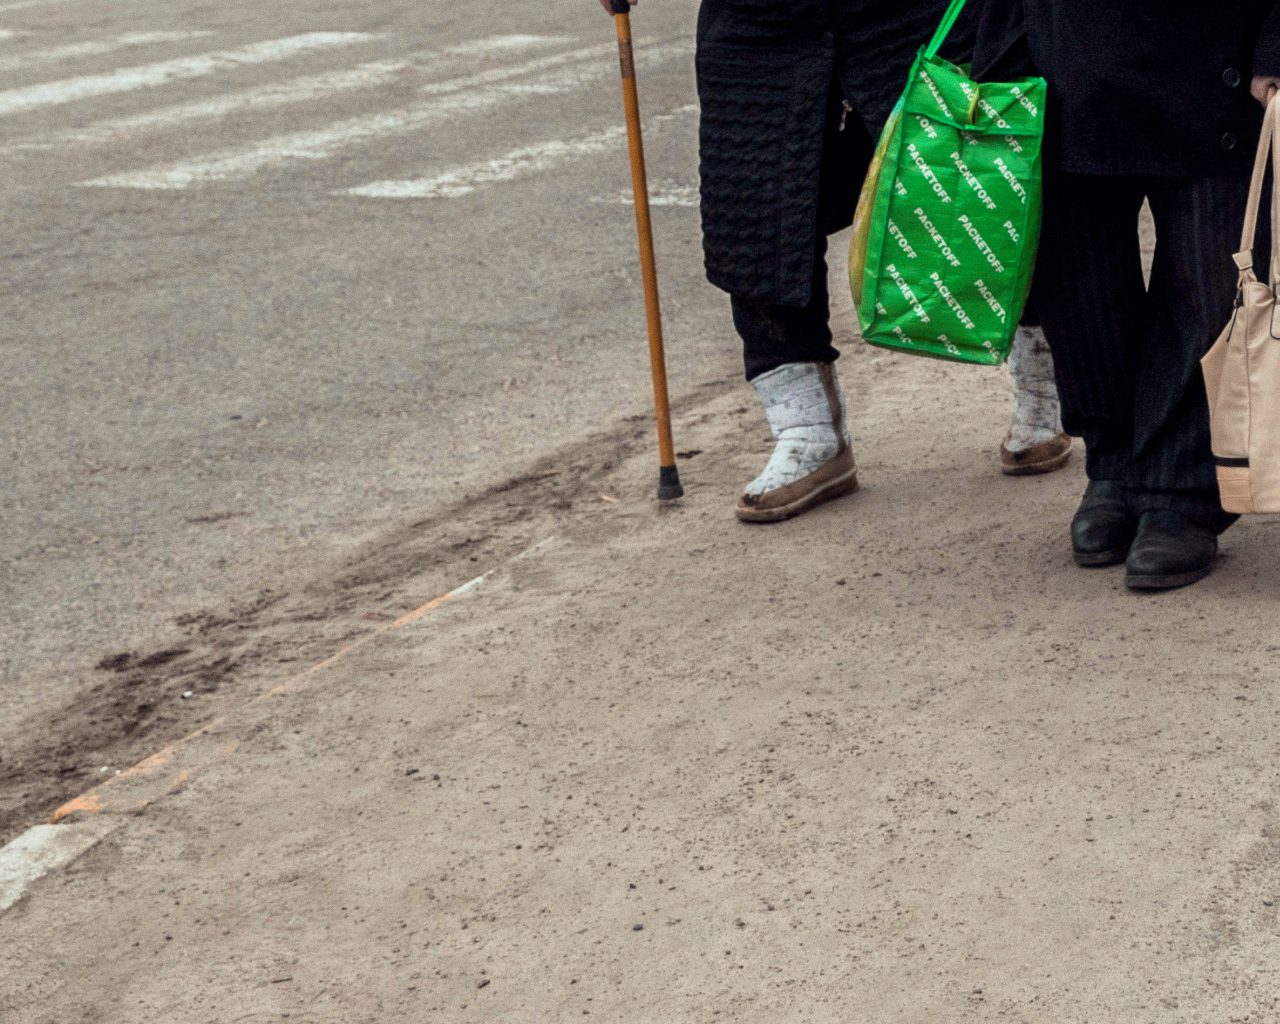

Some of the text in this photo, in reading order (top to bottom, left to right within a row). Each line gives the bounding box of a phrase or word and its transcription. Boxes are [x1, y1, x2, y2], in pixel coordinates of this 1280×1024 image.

[907, 143, 951, 203] PACKETOFF
[950, 152, 996, 210] PACKETOFF
[914, 208, 960, 267] PACKETOFF
[958, 215, 1004, 273] PACKETOFF
[886, 264, 930, 323] PACKETOFF
[930, 272, 974, 330] PACKETOFF
